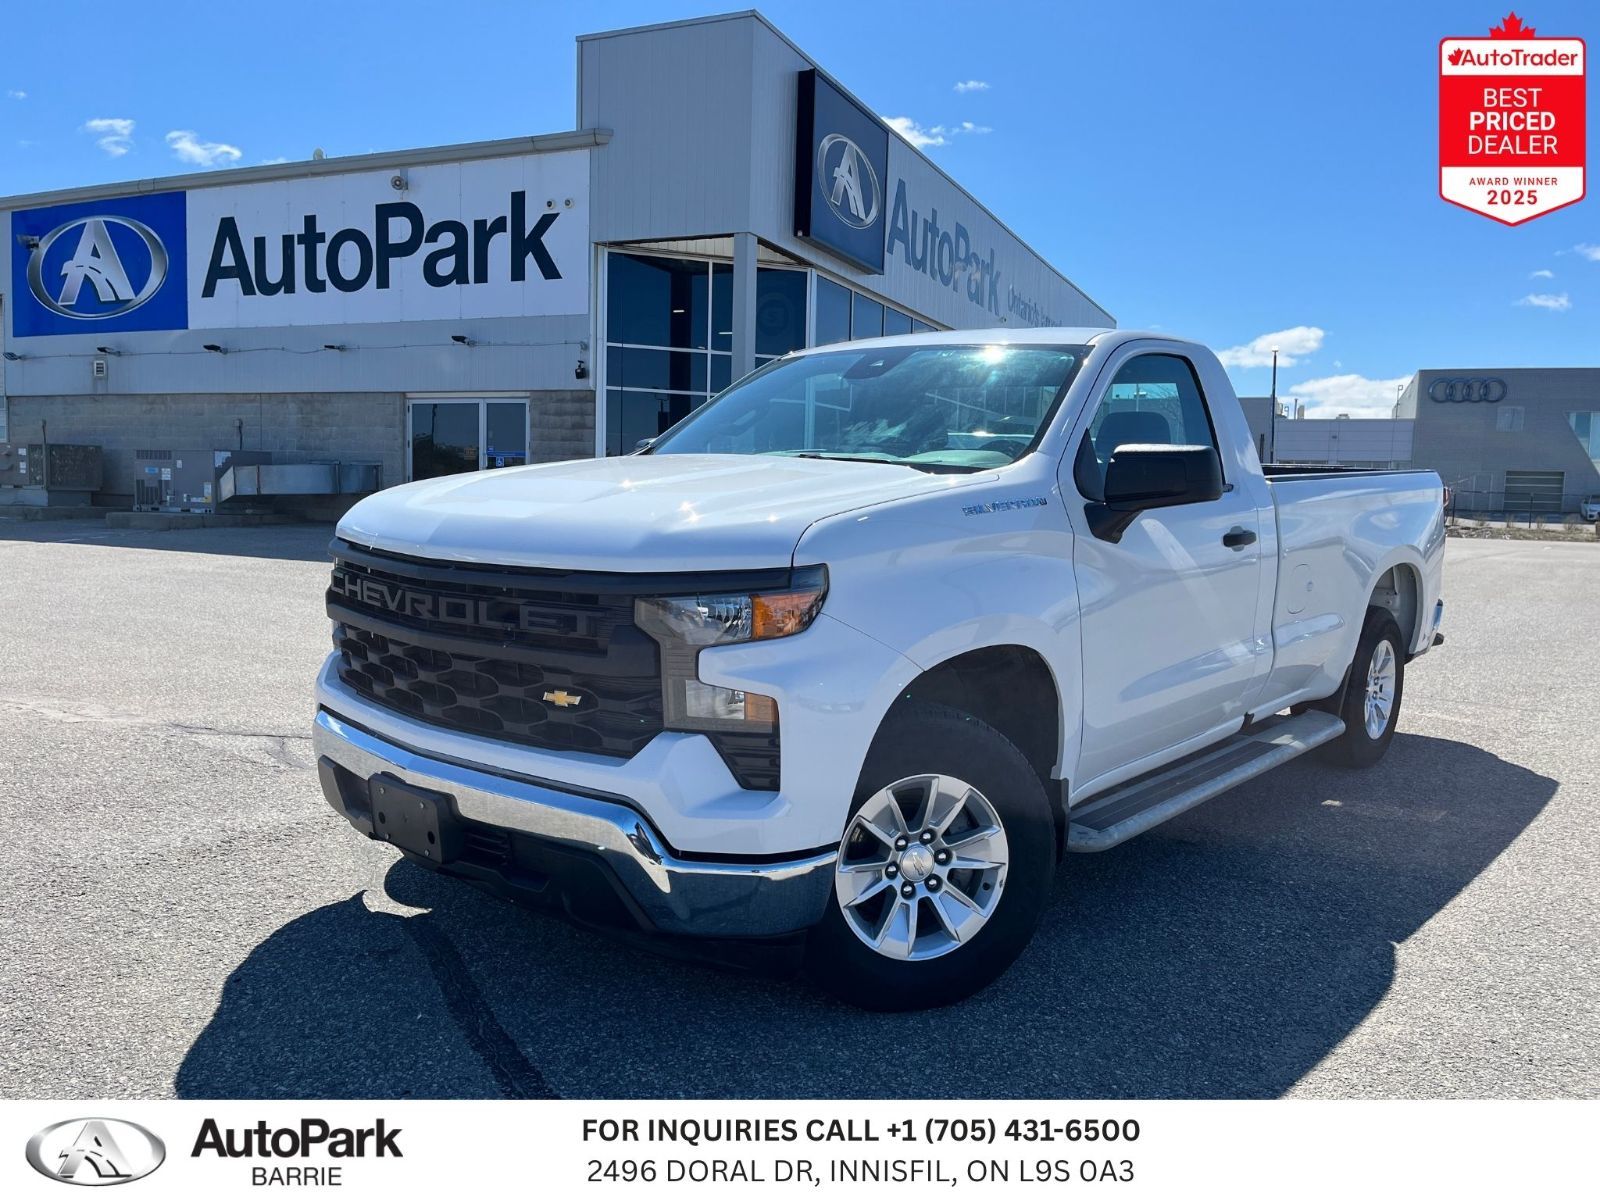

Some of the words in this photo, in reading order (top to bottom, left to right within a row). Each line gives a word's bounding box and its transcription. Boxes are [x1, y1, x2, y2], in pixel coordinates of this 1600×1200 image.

[201, 190, 563, 298] AutoPark
[886, 177, 1002, 317] AutoPark
[331, 572, 606, 637] CHEVROLET
